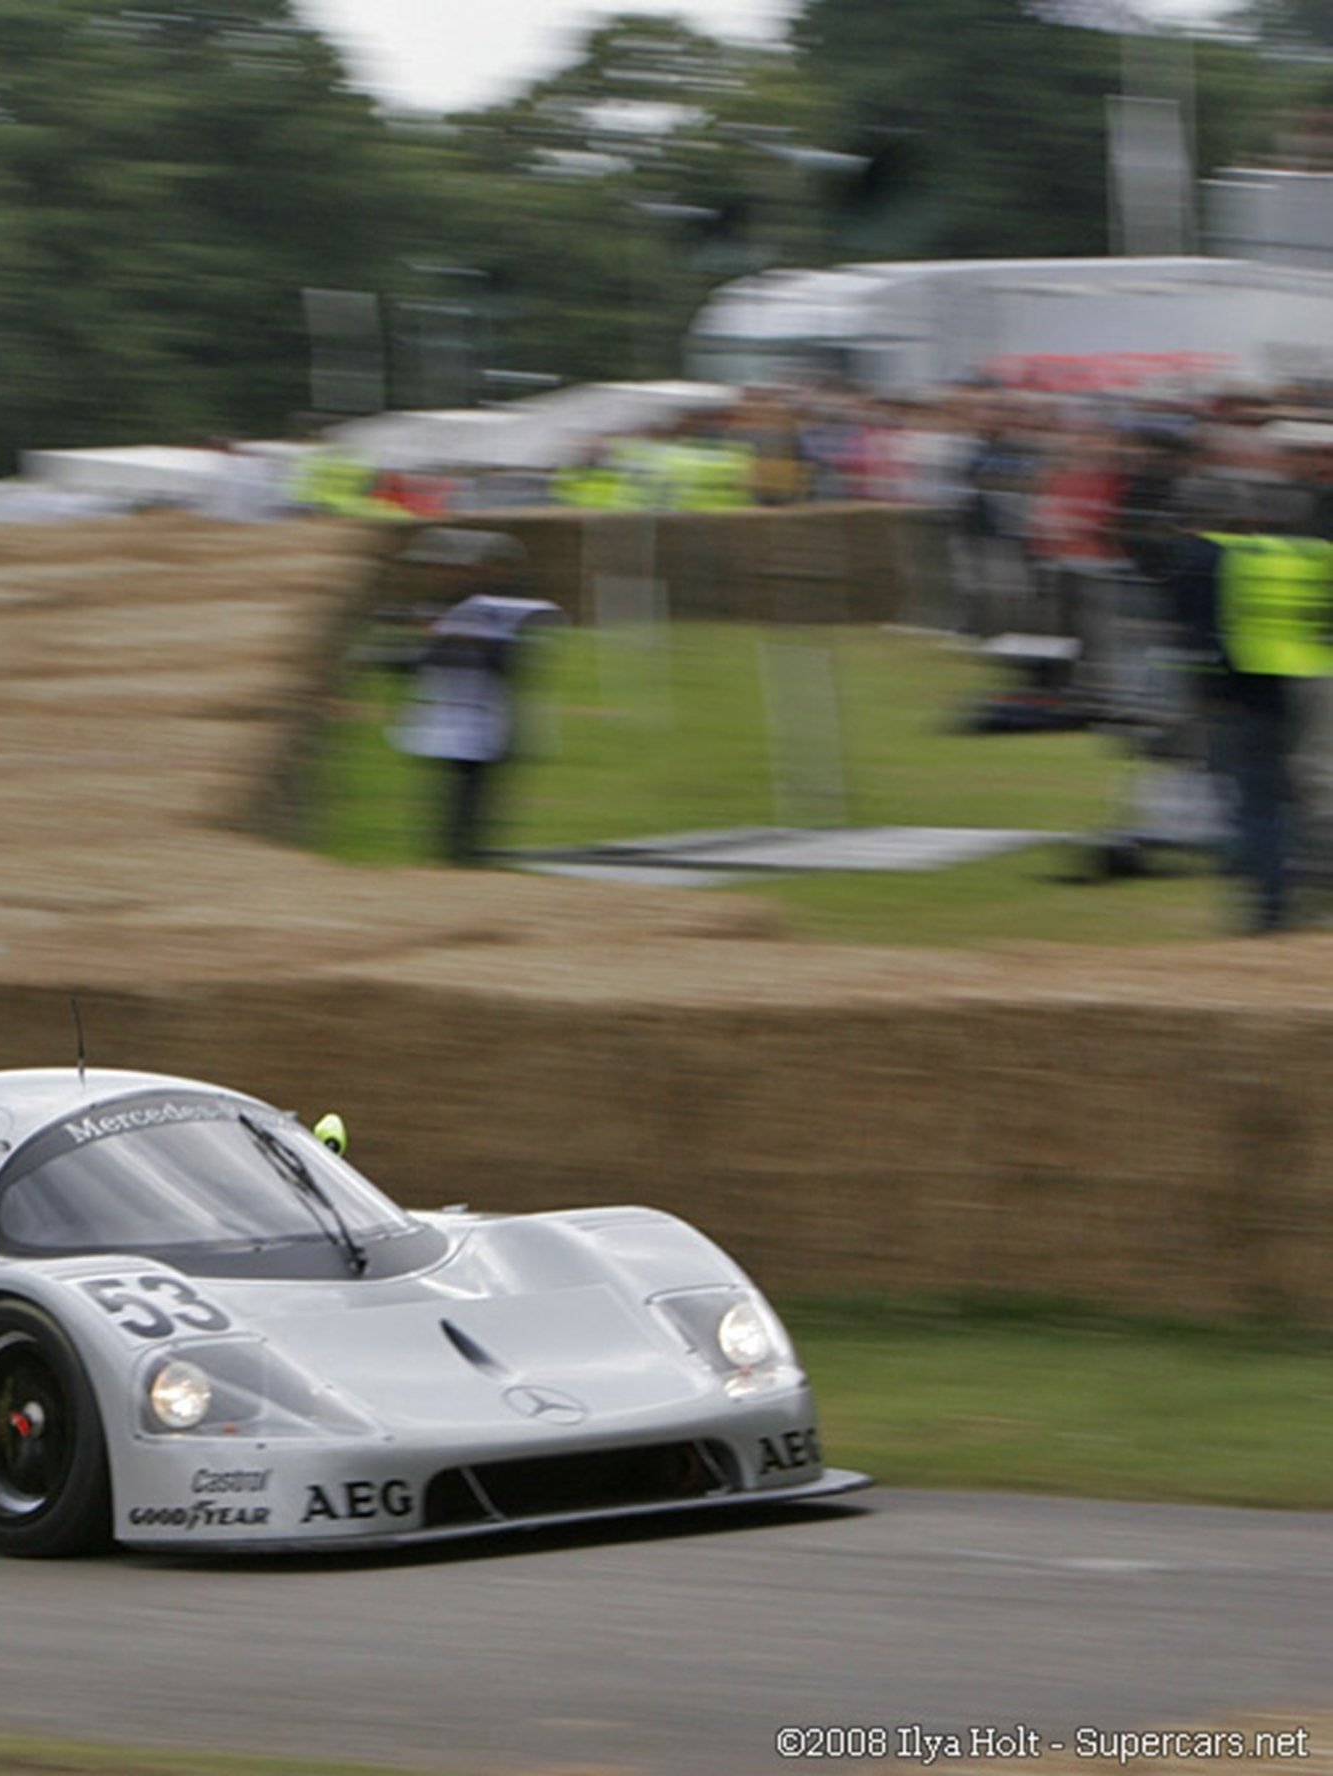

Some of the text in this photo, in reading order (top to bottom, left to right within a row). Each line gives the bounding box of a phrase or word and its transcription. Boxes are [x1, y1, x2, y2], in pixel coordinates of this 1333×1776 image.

[80, 1275, 231, 1338] 53
[191, 1469, 272, 1494] Castrol
[300, 1479, 415, 1524] AEG
